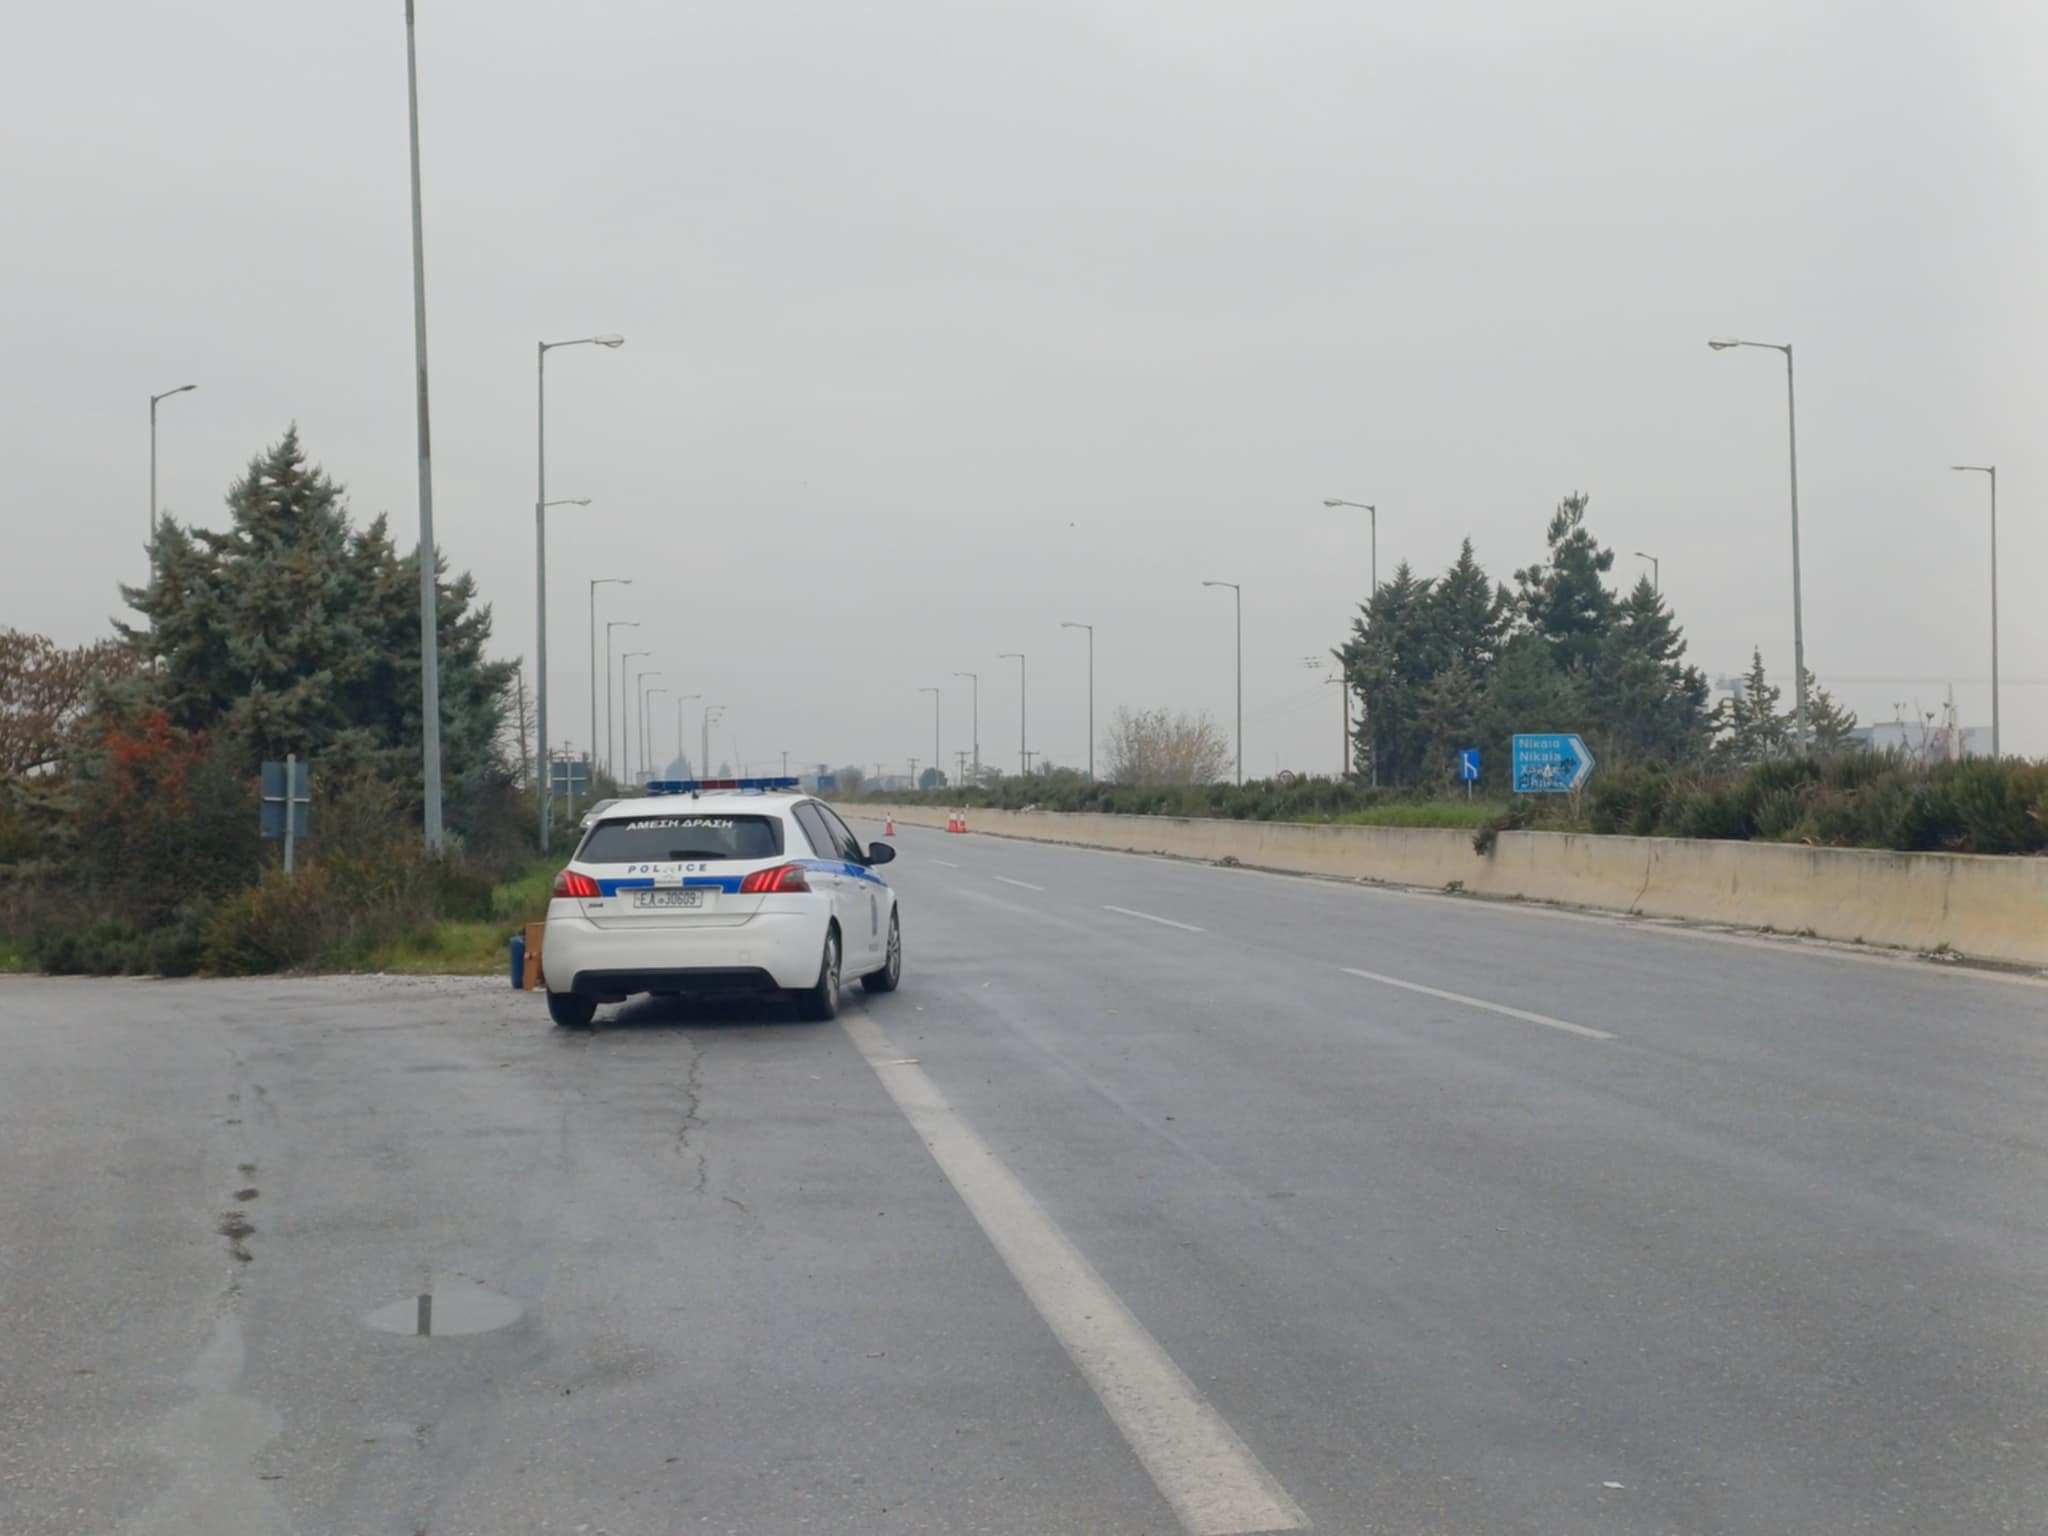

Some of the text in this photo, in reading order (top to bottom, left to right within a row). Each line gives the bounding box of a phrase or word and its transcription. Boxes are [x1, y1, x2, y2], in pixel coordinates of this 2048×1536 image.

[1519, 751, 1561, 762] Nikaia
[625, 819, 733, 831] ΑΜΕΣΗ ΔΡΑΣΗ
[627, 863, 707, 874] POLICE
